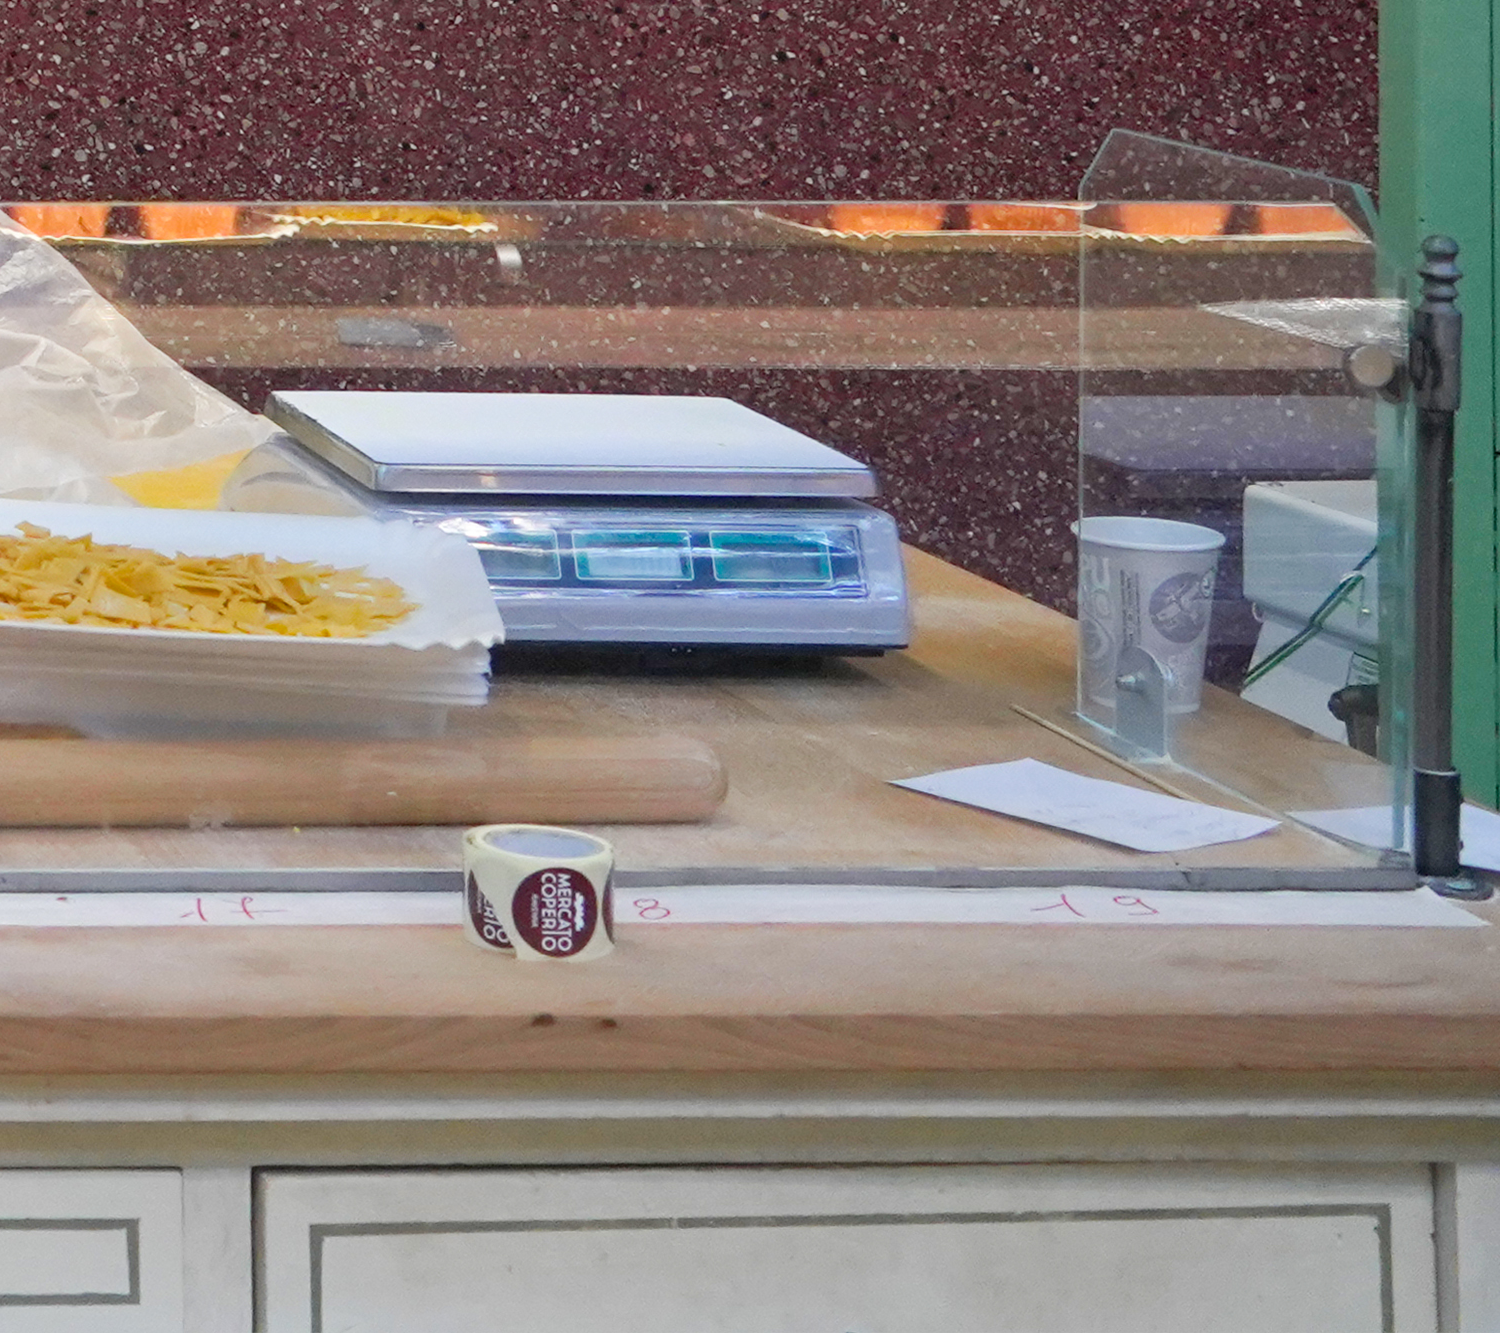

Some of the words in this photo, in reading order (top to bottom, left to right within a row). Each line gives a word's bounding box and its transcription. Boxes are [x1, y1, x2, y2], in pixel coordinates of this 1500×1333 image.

[541, 872, 557, 951] COPERTO
[557, 873, 573, 951] MERCATO
[634, 898, 671, 920] 8
[1030, 893, 1158, 917] 19
